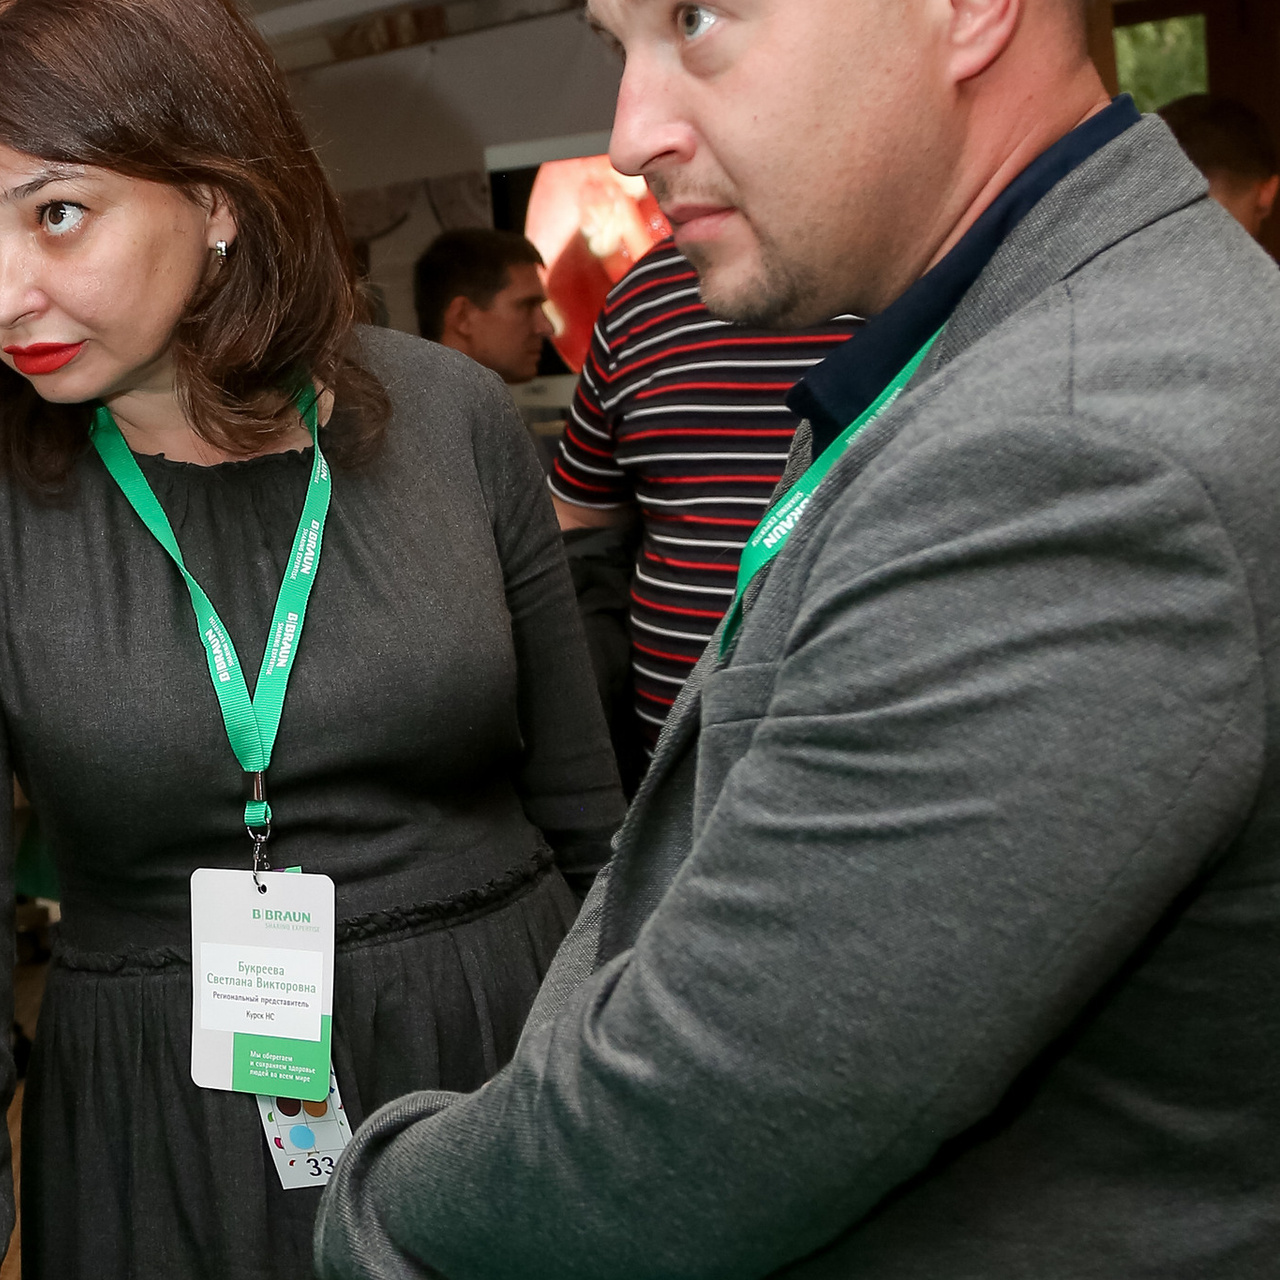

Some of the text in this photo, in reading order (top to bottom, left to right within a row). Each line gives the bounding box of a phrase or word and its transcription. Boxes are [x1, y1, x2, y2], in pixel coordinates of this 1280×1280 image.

[238, 960, 285, 977] Букреева
[206, 972, 316, 994] Светлана Викторовна
[212, 990, 310, 1008] Региональный представитель
[246, 1009, 265, 1021] Курск
[250, 1050, 294, 1063] Мы оберегаем
[255, 1061, 288, 1071] сохраняем
[288, 1065, 317, 1075] здоровье
[250, 1069, 270, 1078] людей
[295, 1074, 312, 1084] мире
